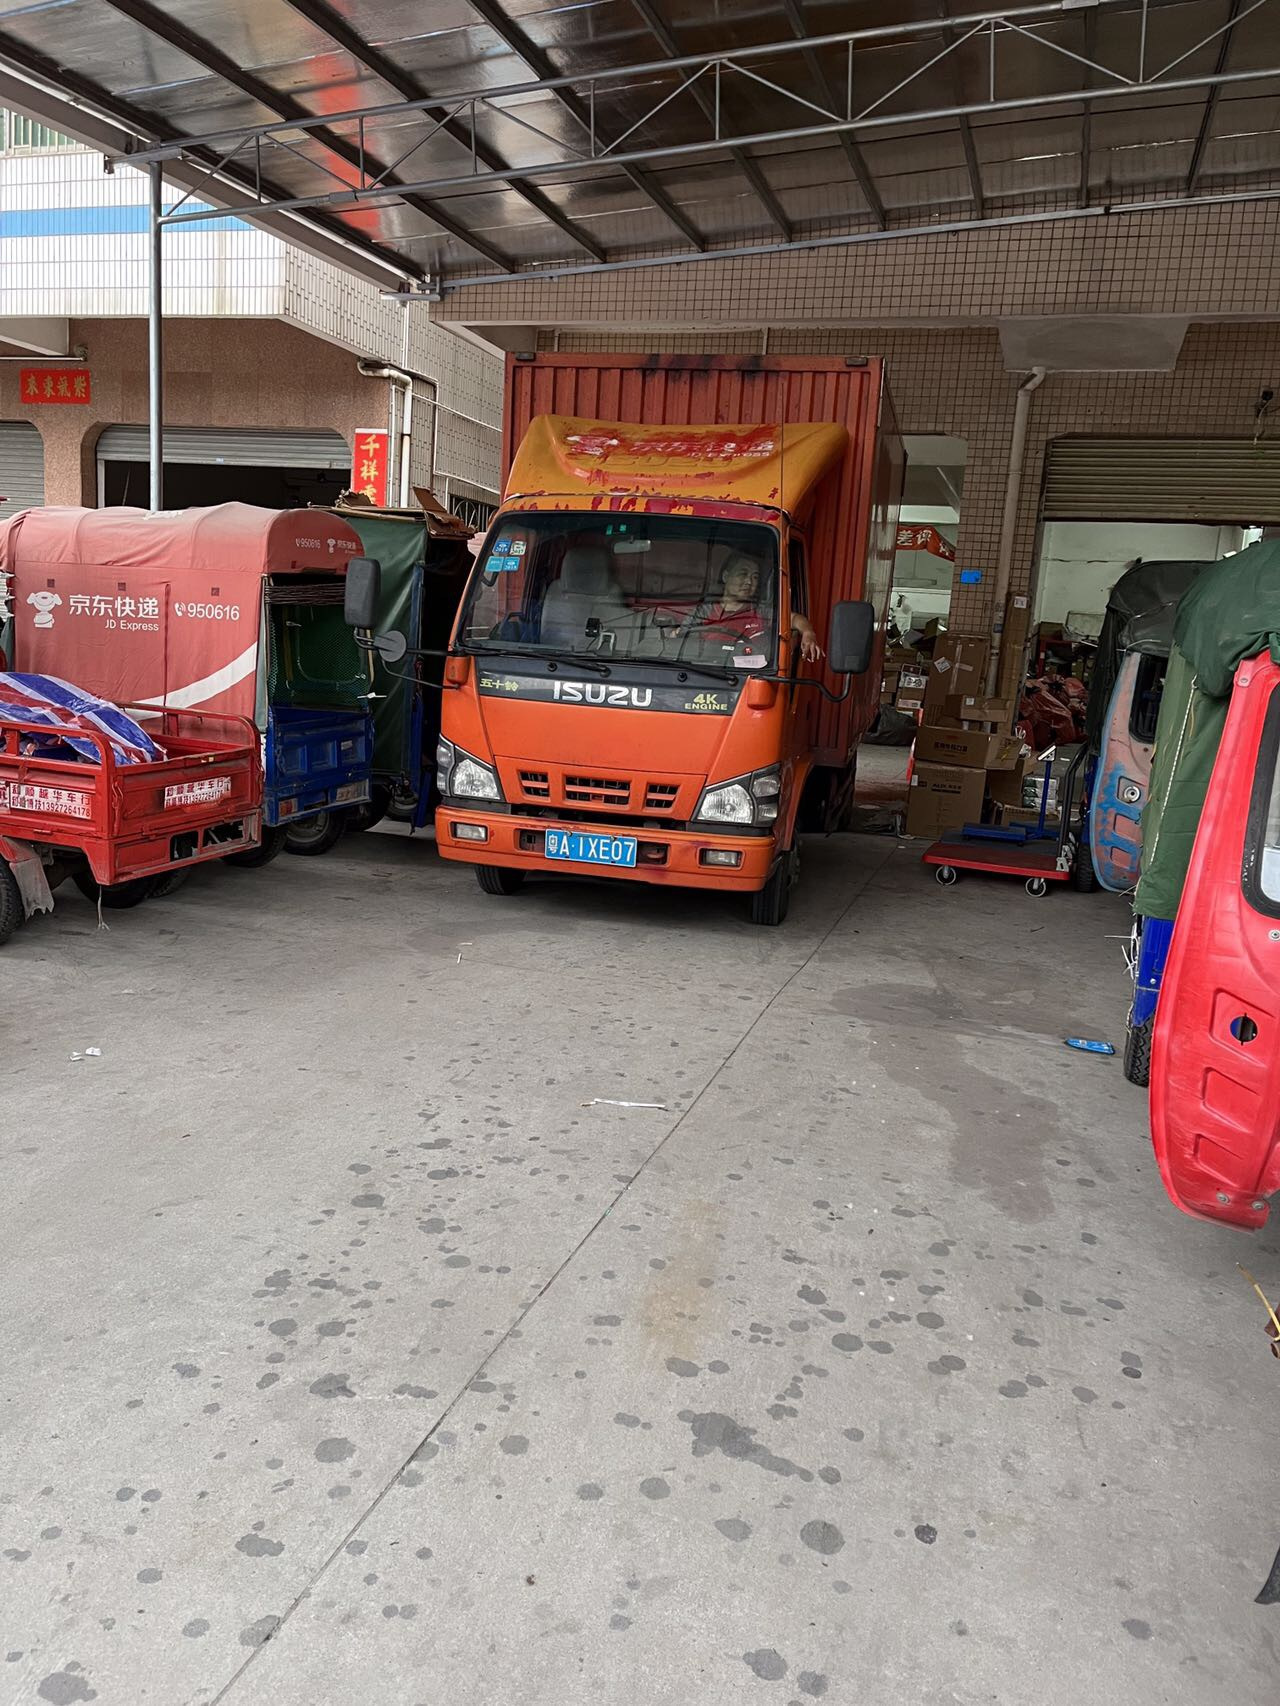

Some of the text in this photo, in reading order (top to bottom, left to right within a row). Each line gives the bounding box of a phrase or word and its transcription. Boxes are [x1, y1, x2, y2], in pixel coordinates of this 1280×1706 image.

[69, 594, 159, 619] 京东快递
[187, 602, 240, 621] 950616
[105, 619, 159, 632] JD Express
[553, 680, 652, 708] ISUZU
[693, 693, 718, 706] 4K
[685, 702, 728, 712] ENGINE
